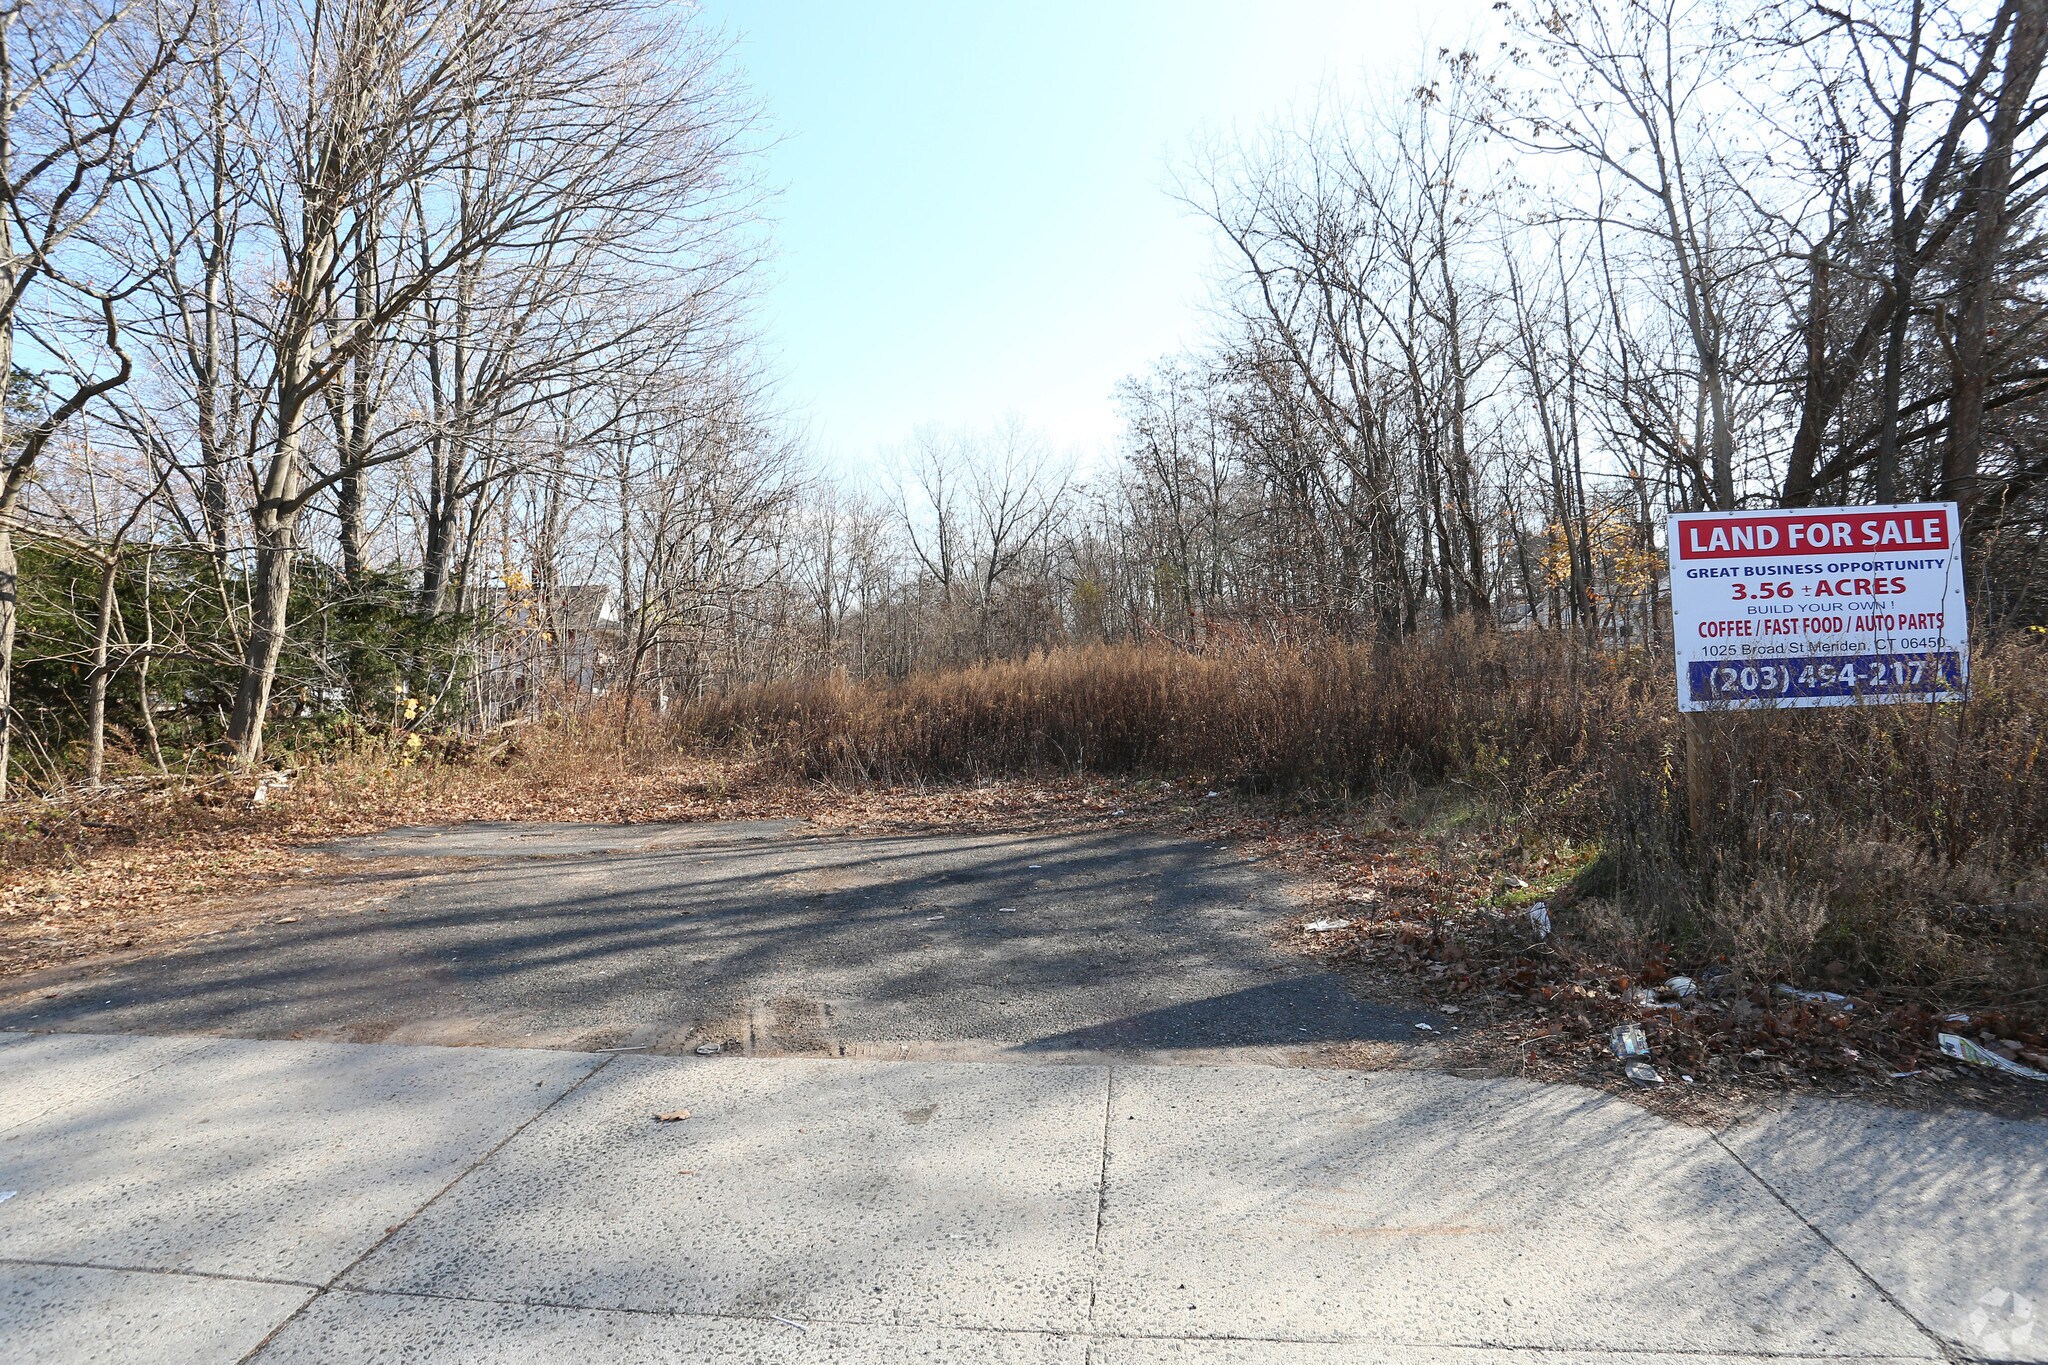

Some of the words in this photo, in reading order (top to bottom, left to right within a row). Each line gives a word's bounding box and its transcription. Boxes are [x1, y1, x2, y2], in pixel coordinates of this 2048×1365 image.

[1690, 525, 1779, 553] LAND
[1788, 522, 1853, 548] FOR
[1861, 518, 1942, 546] SALE
[1686, 567, 1739, 579] GREAT
[1744, 564, 1823, 576] BUSINESS
[1827, 559, 1945, 573] OPPORTUNITY
[1731, 582, 1794, 600] 3.56
[1747, 604, 1794, 615] BUILD
[1798, 602, 1844, 613] YOUR
[1848, 601, 1887, 611] OWN
[1698, 620, 1752, 639] COFFEE
[1764, 617, 1799, 636] FAST
[1802, 616, 1843, 634] FOOD
[1855, 613, 1895, 632] AUTO
[1898, 612, 1945, 631] PARTS
[1702, 644, 1737, 657] 1025
[1741, 643, 1784, 656] Broad
[1789, 641, 1805, 653] St
[1876, 638, 1897, 650] CT
[1901, 636, 1946, 650] 06450
[1709, 664, 1790, 696] (203)
